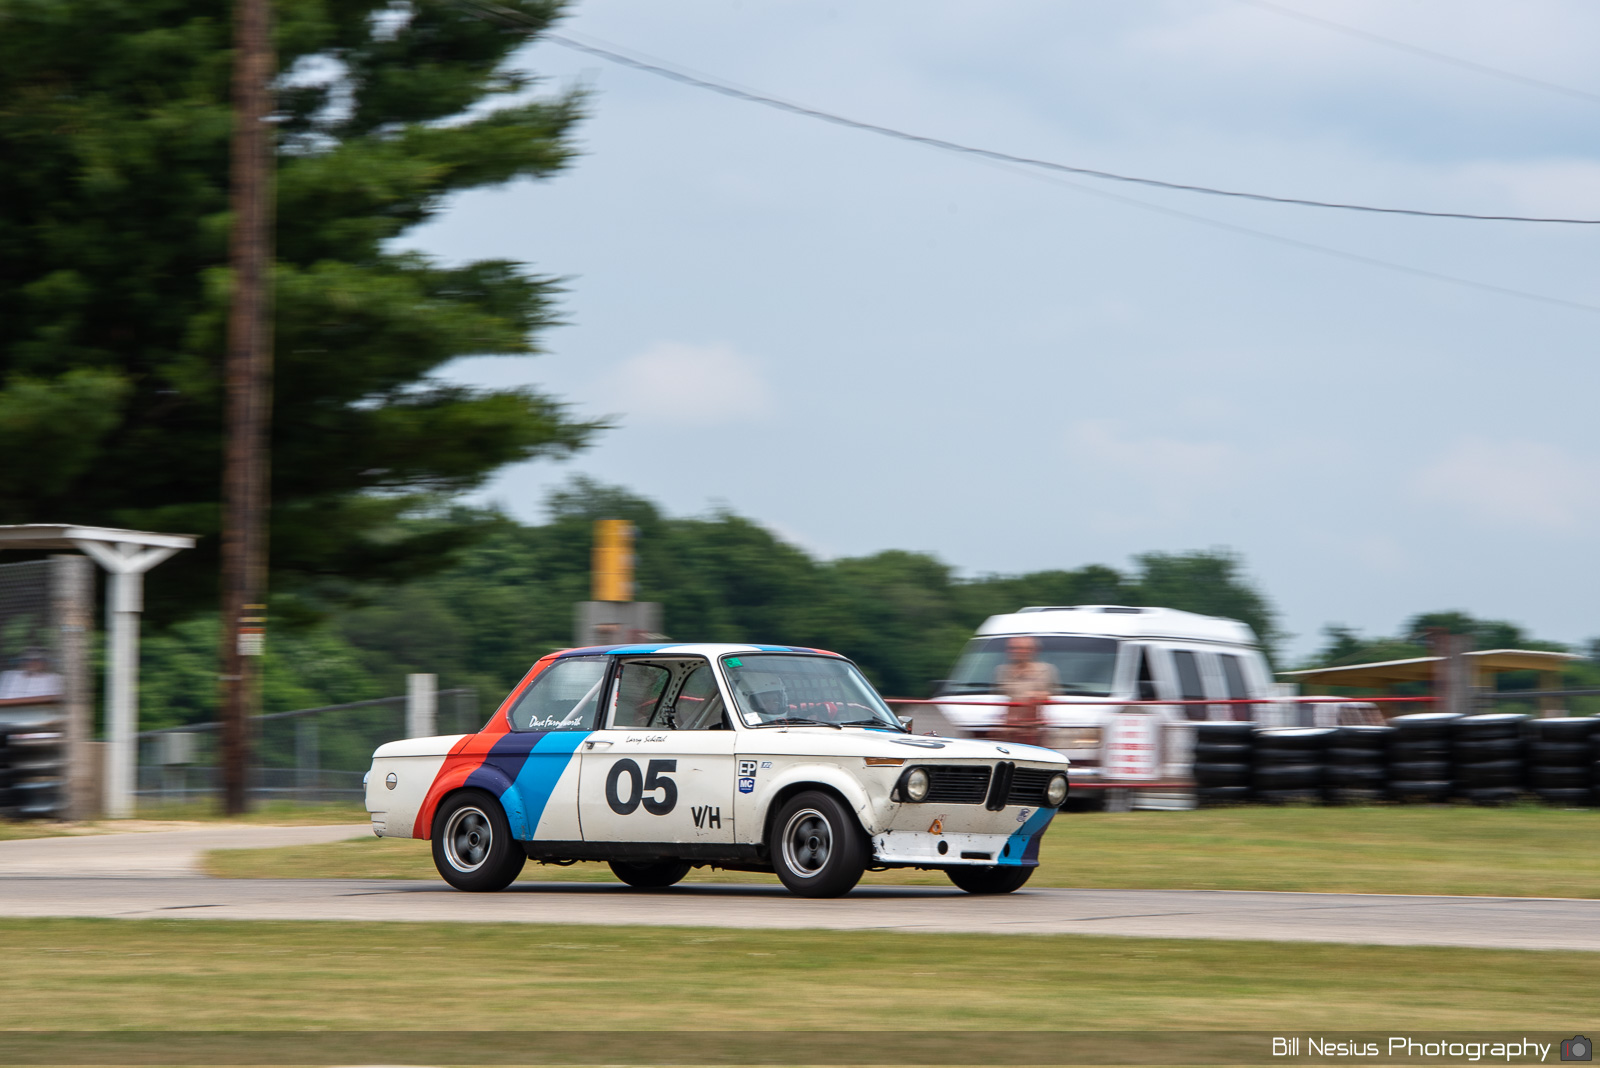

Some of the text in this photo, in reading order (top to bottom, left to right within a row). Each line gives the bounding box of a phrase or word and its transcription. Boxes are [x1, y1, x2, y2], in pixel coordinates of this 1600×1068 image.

[739, 761, 757, 776] EP
[605, 758, 678, 816] 05
[740, 779, 753, 788] MC
[691, 804, 721, 829] V/H
